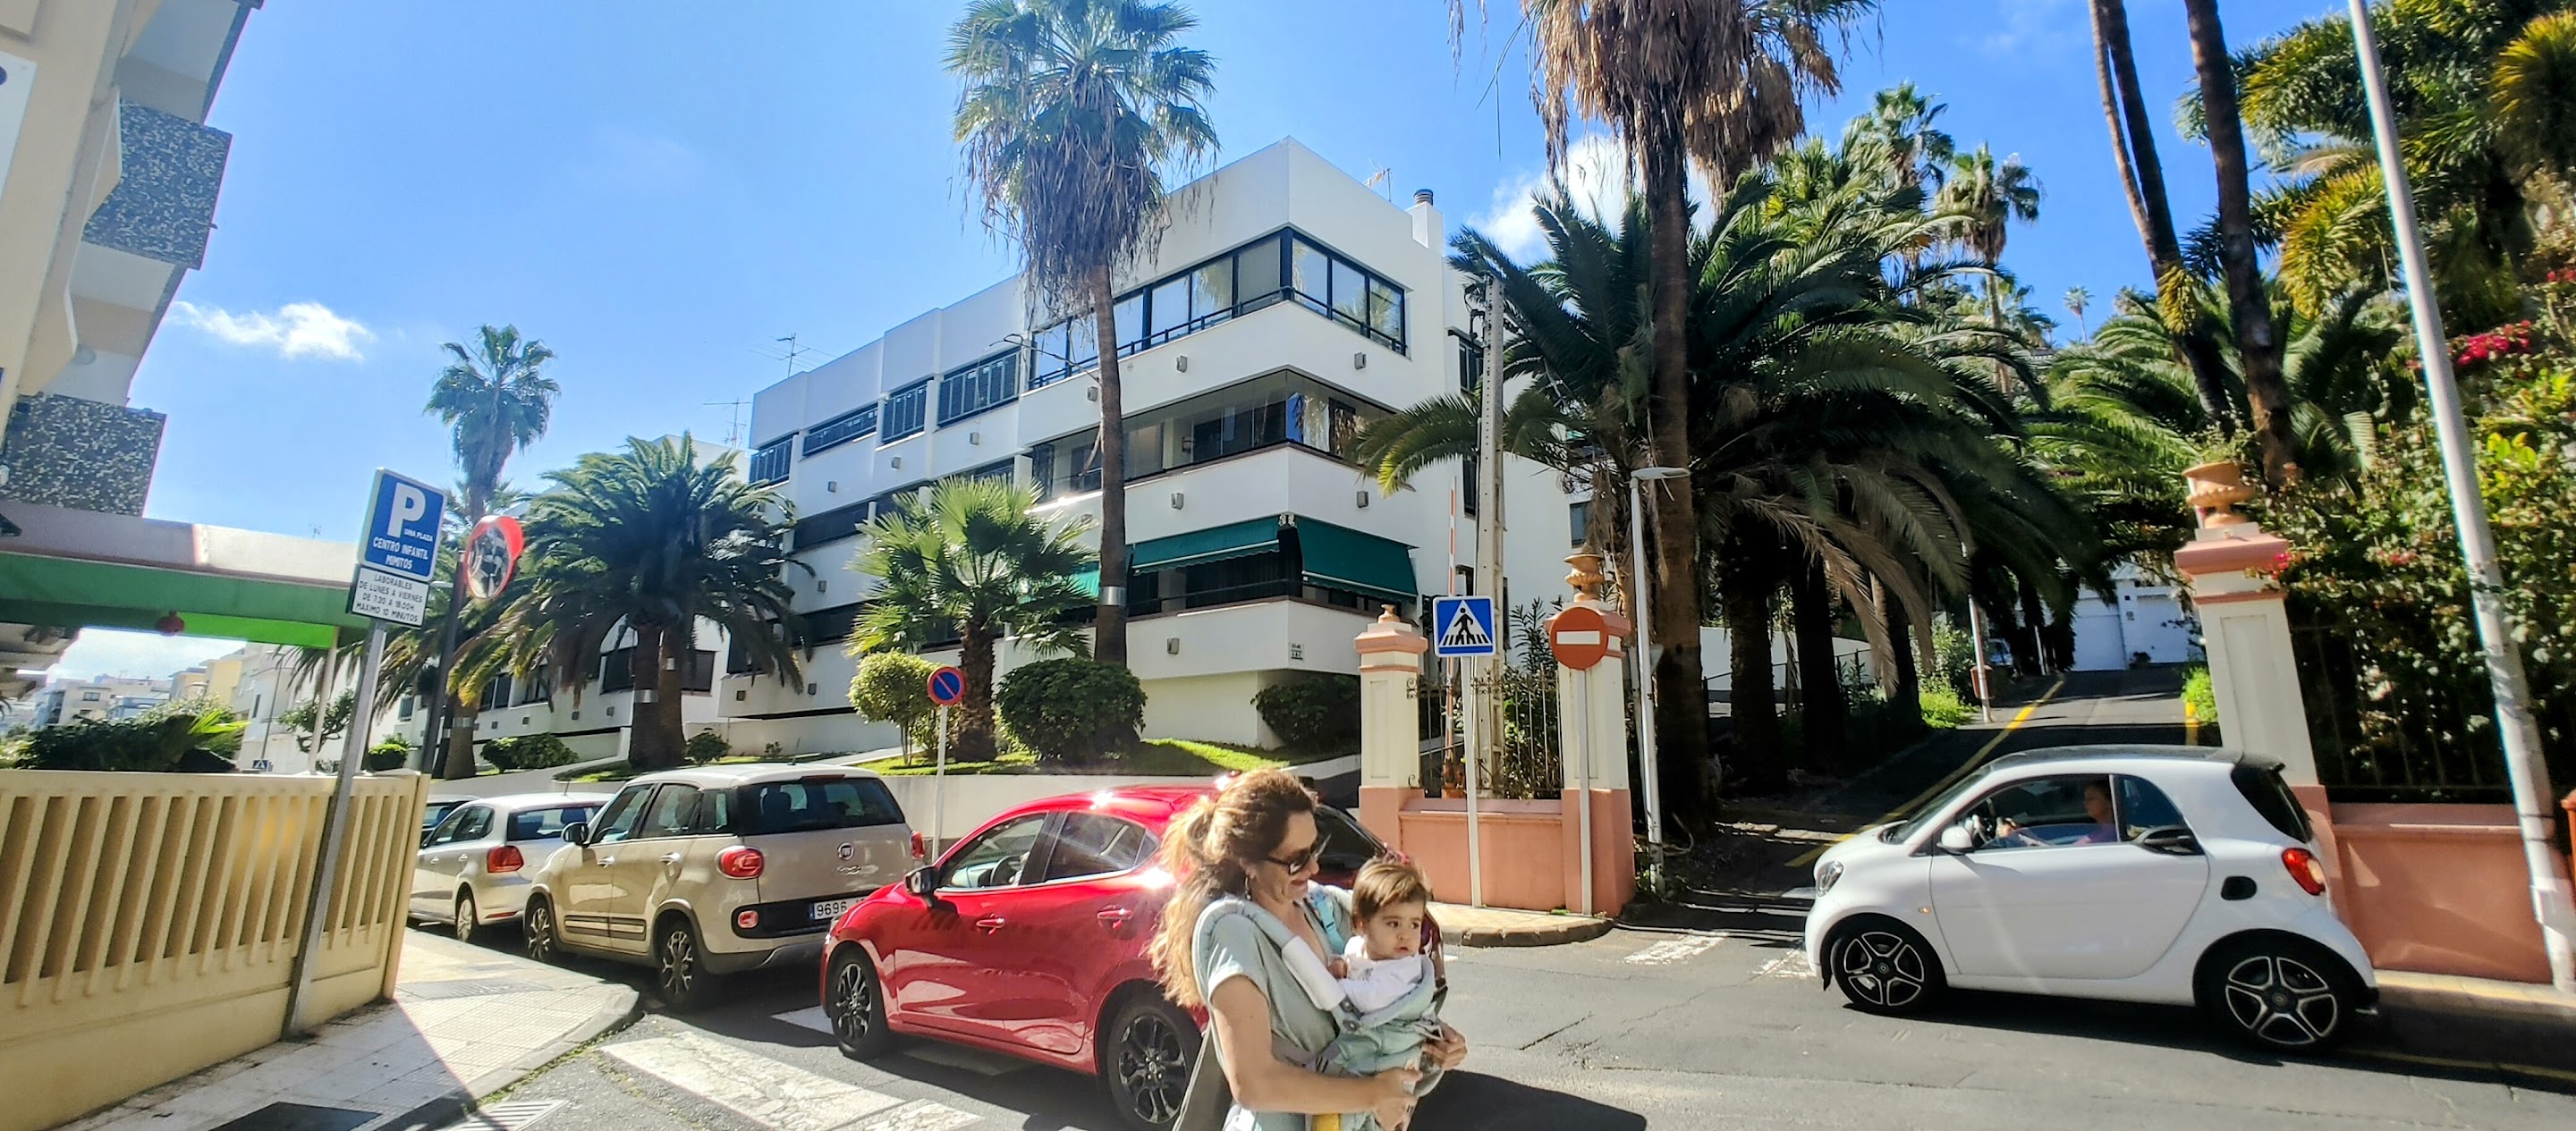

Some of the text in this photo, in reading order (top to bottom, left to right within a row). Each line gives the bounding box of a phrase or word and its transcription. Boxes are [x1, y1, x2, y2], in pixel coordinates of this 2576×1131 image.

[387, 482, 426, 538] P
[403, 528, 433, 543] UNA PLAZA
[373, 536, 428, 561] CENTRO INFANTIL
[375, 574, 412, 590] LABORABLES
[359, 580, 368, 590] DE
[369, 584, 389, 595] LUNES
[398, 591, 422, 603] VIERNES
[362, 592, 370, 602] DE
[357, 602, 418, 622] MAXIMO 10 MINUTOS
[817, 901, 847, 916] 9696
